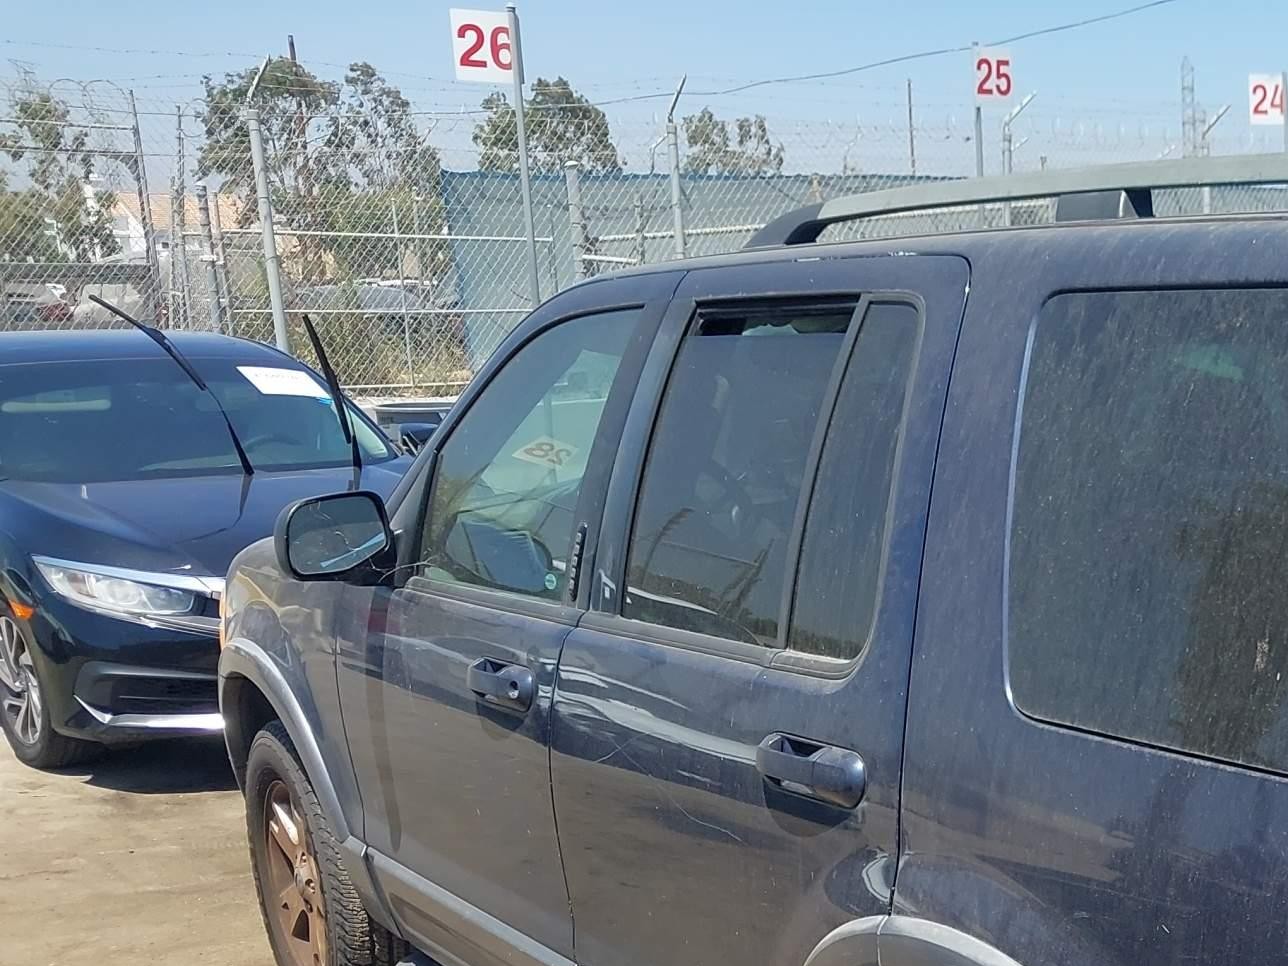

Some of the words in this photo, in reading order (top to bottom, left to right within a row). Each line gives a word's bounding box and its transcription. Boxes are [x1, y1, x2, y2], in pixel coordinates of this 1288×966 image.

[457, 23, 513, 71] 26
[976, 58, 1012, 96] 25
[1252, 84, 1285, 114] 24
